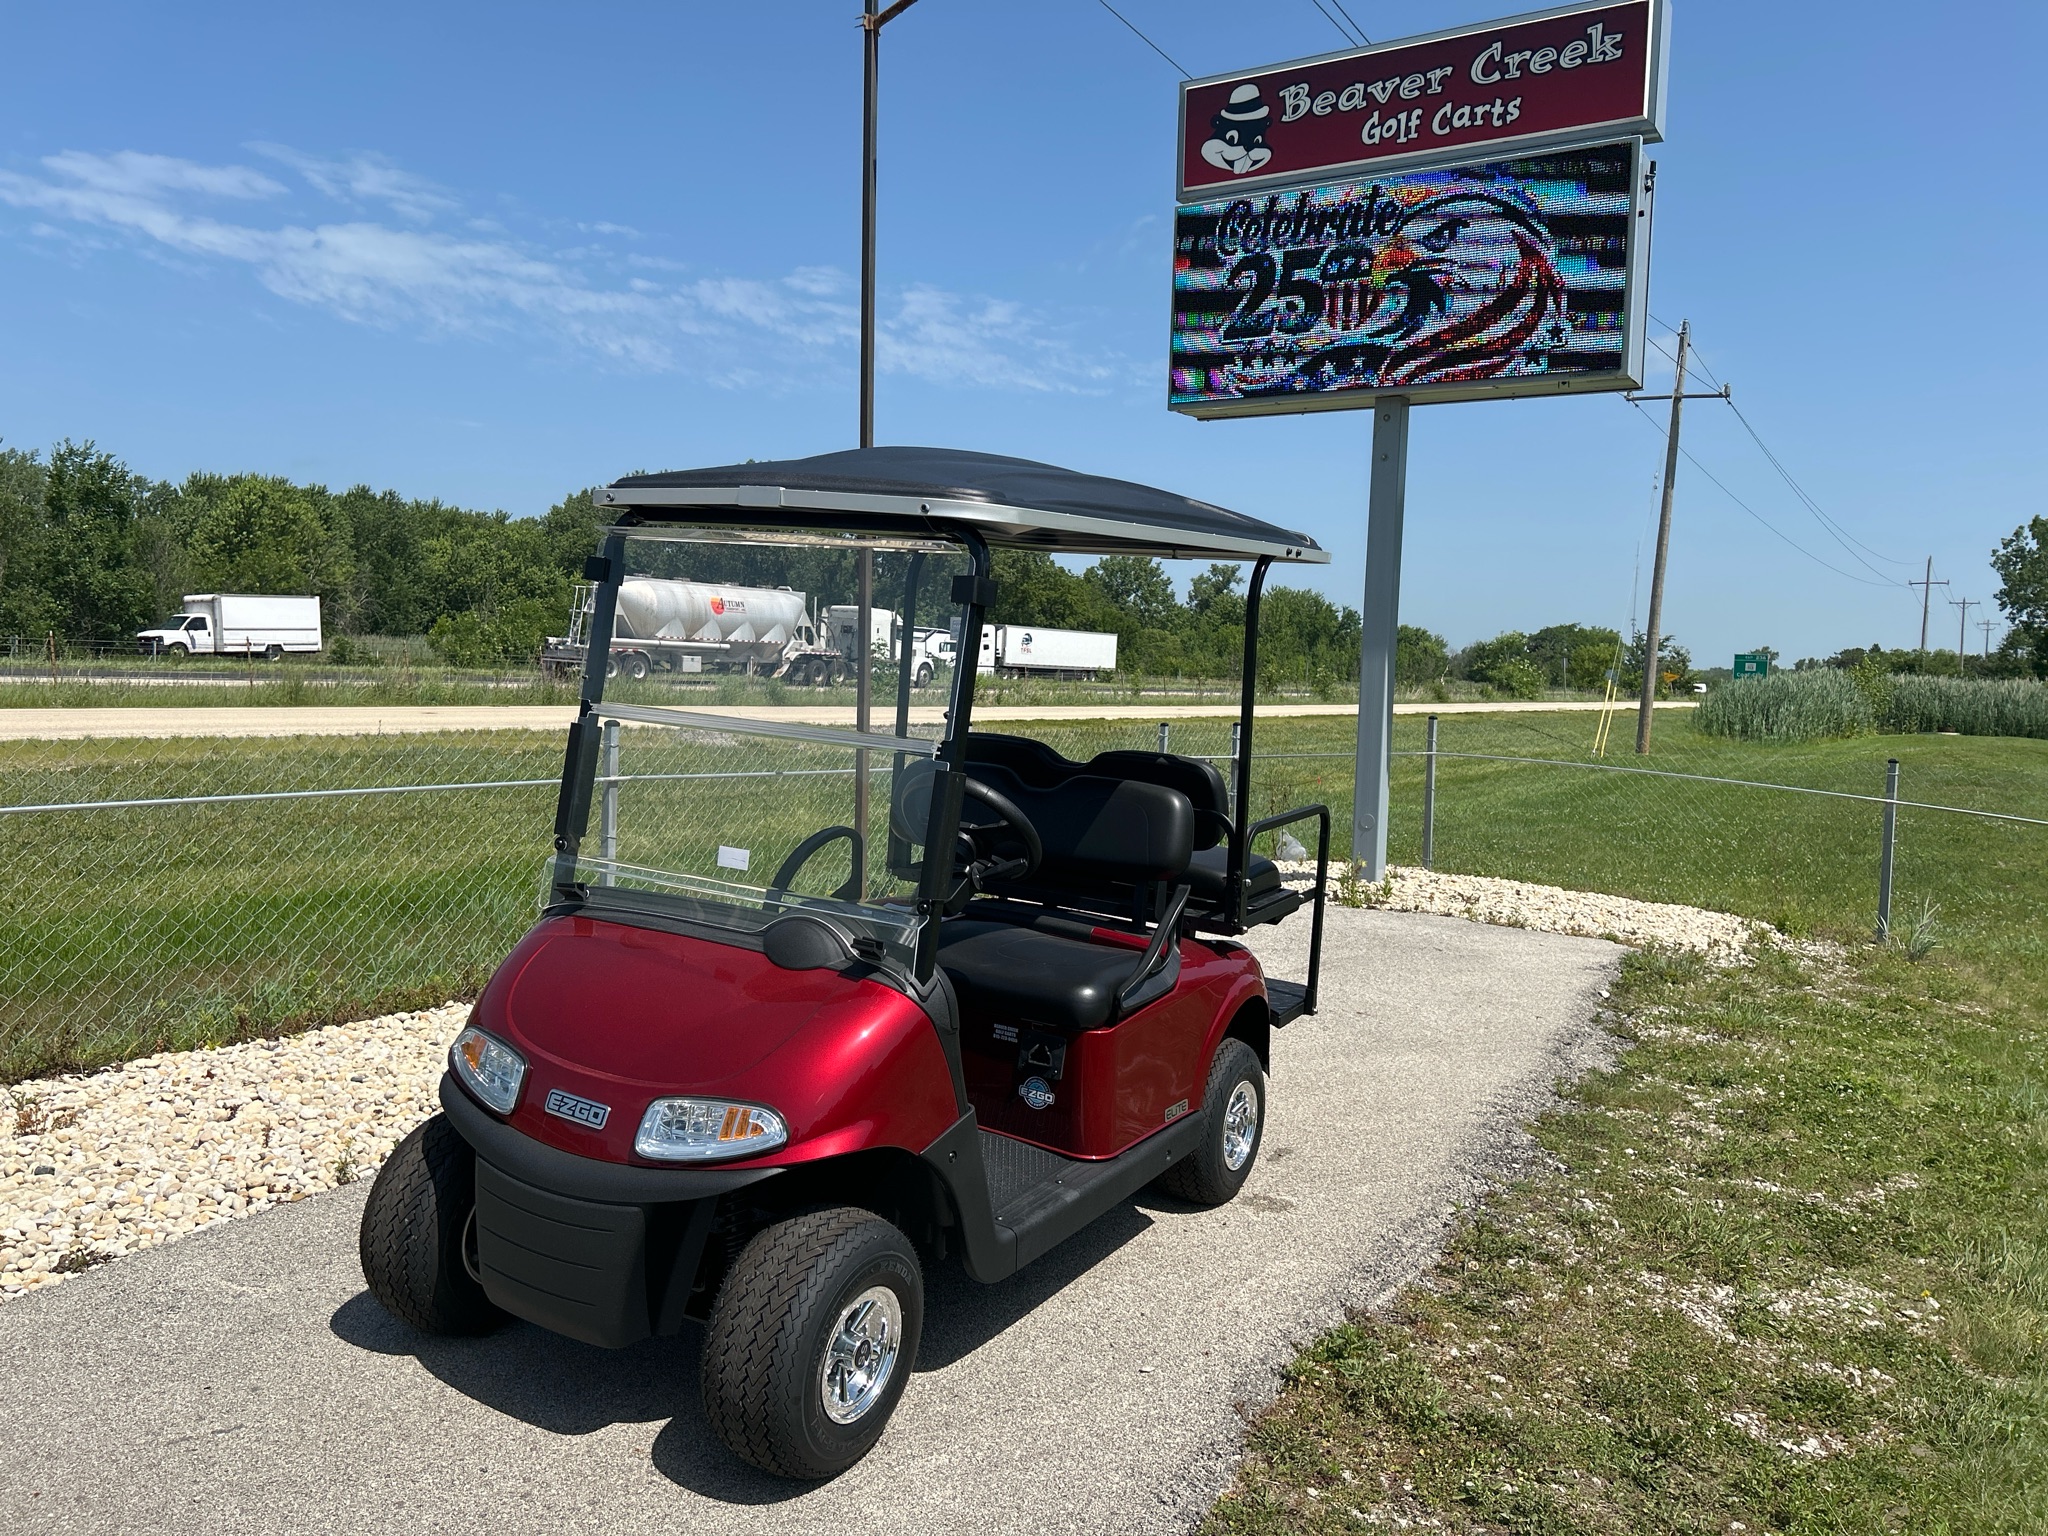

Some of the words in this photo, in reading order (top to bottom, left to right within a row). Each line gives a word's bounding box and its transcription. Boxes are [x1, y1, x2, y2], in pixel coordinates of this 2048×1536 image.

[1278, 64, 1454, 124] Beaver
[1470, 22, 1624, 86] Creek
[1361, 111, 1421, 146] Golf
[1432, 97, 1522, 137] Carts
[1216, 184, 1402, 256] Celebrate
[1166, 1101, 1187, 1120] ELITE
[879, 1260, 913, 1286] KENDA
